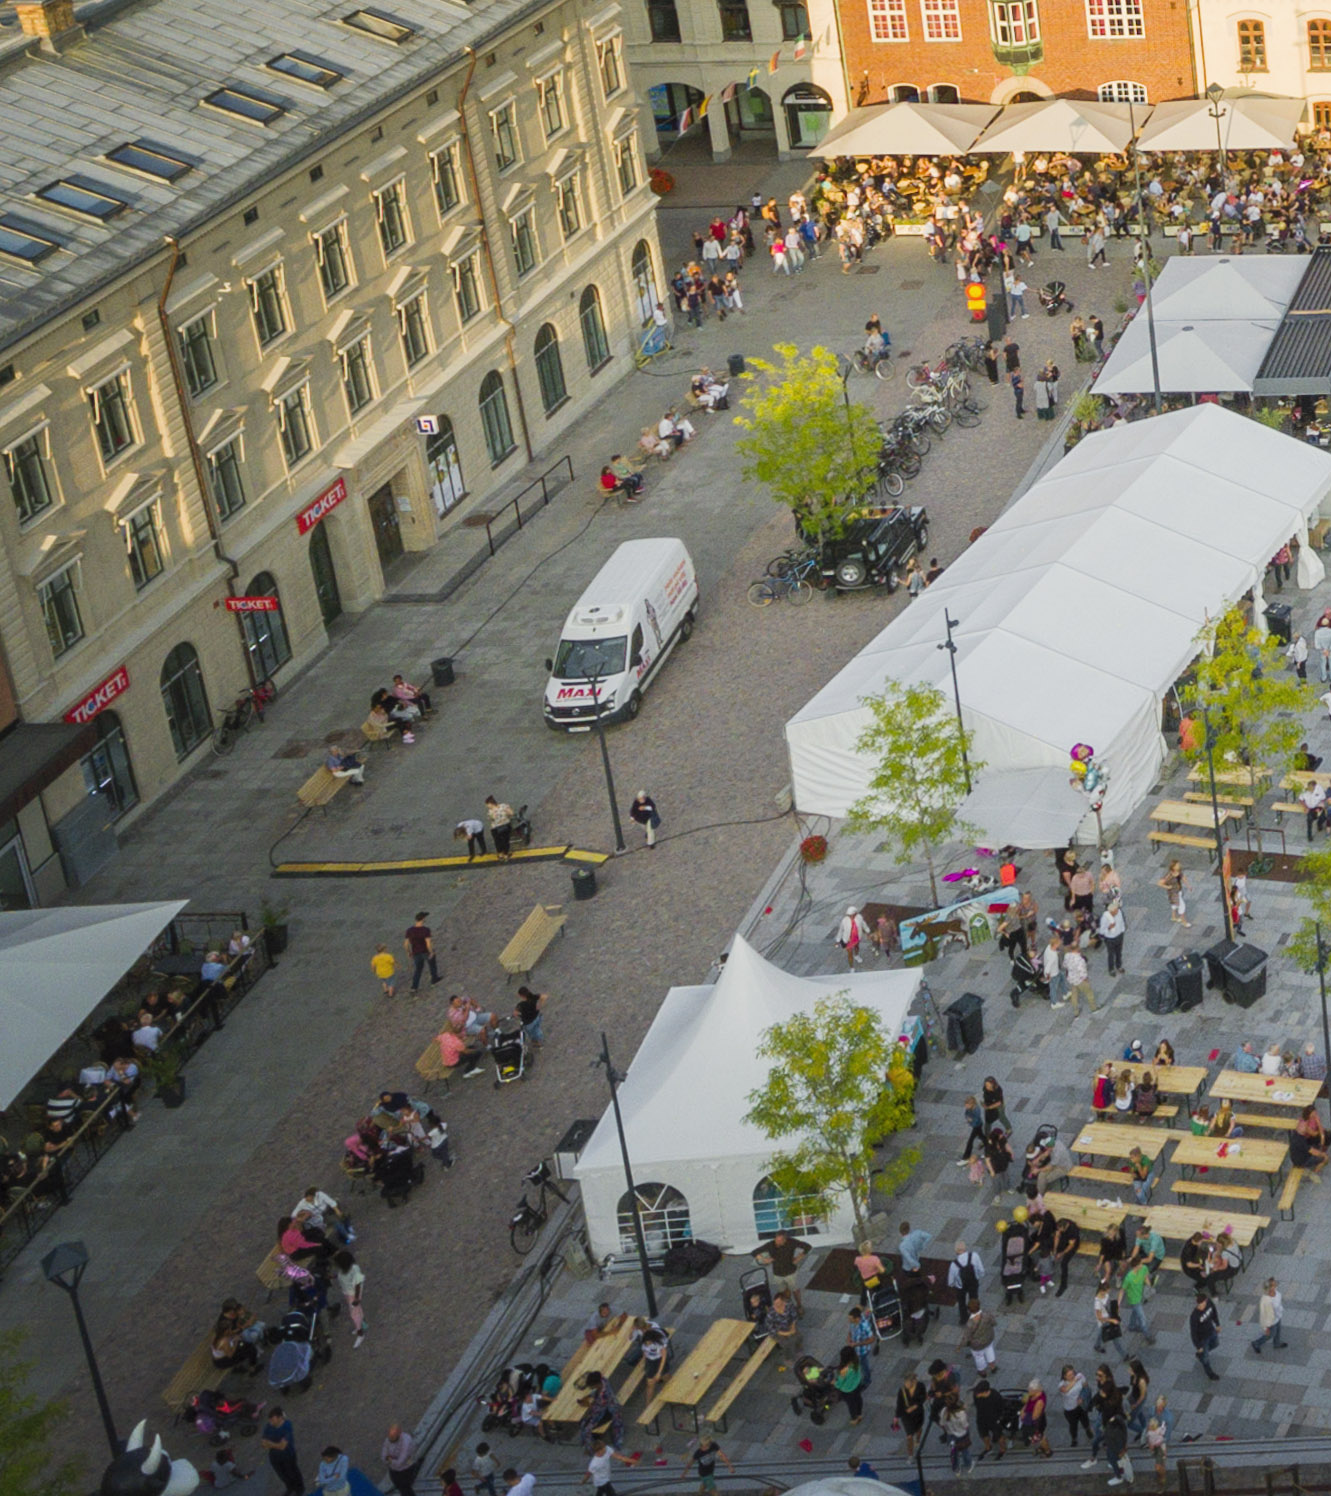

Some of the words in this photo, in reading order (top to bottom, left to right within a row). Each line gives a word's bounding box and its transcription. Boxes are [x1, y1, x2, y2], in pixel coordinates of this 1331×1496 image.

[302, 484, 342, 526] TICKET
[228, 600, 272, 609] TICKET
[72, 673, 124, 723] TICKET
[557, 687, 602, 699] MAXI
